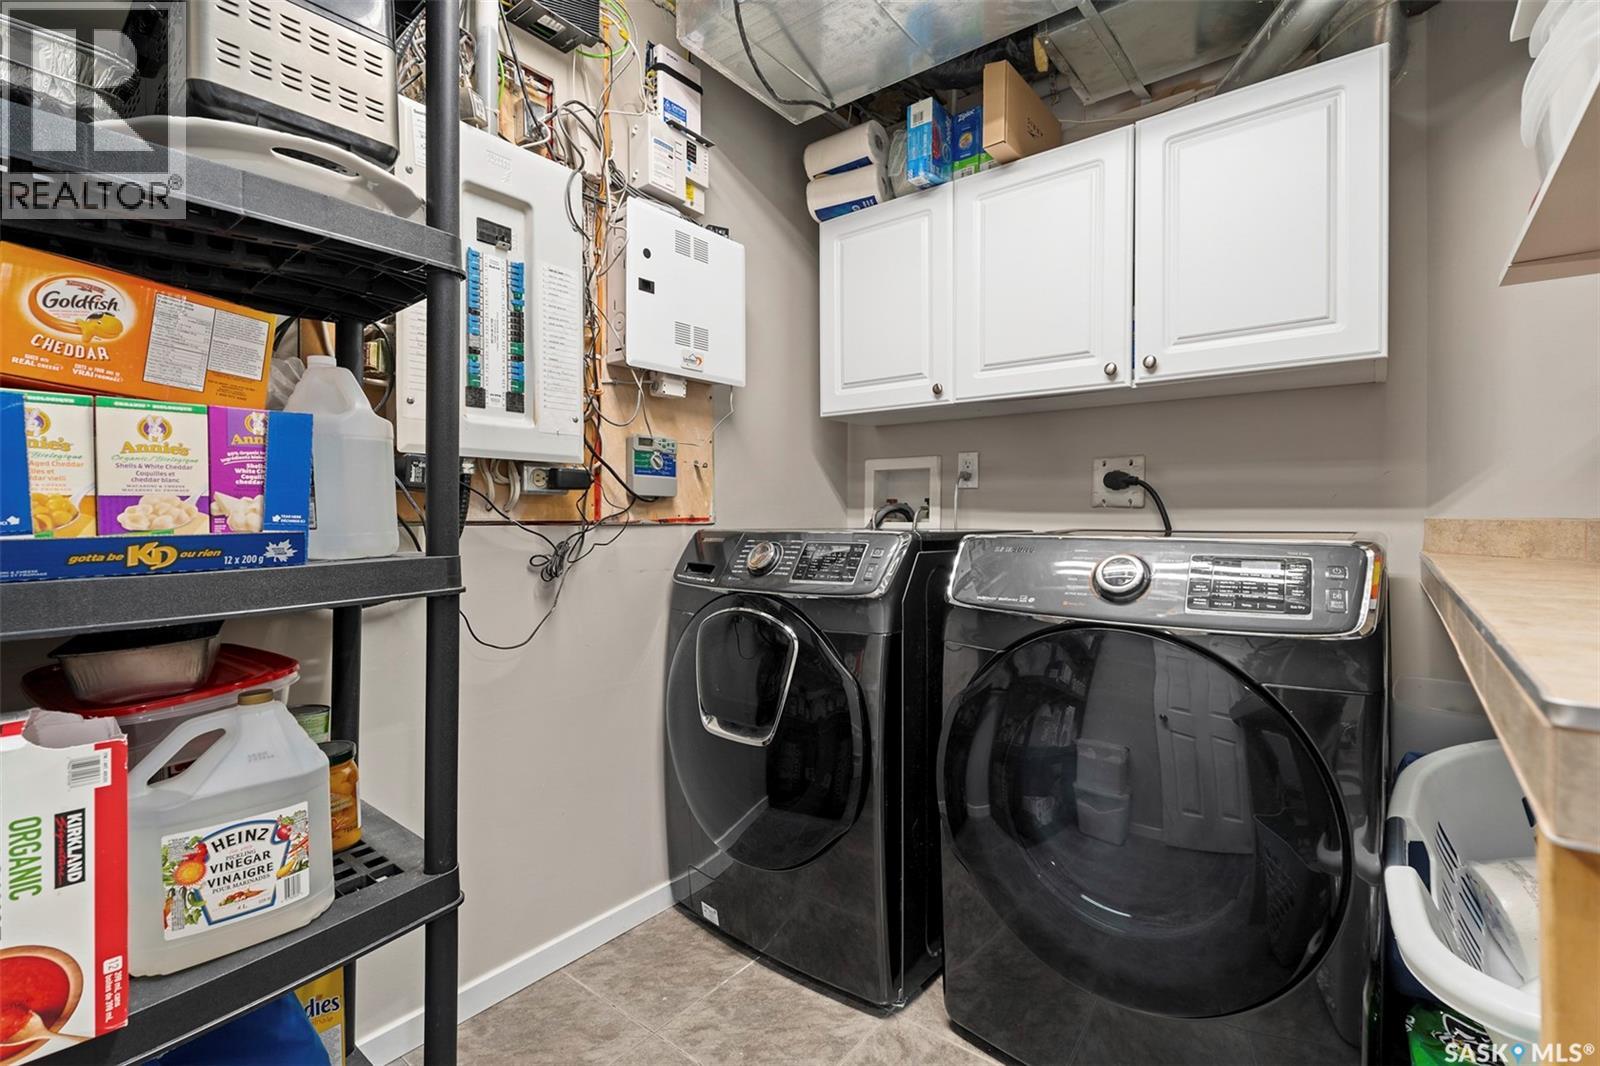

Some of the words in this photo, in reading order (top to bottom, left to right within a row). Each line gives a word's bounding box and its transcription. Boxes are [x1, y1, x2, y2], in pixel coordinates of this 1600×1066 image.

[42, 290, 119, 312] Goldfish
[31, 334, 110, 360] CHEDDAR
[120, 440, 191, 457] Annie's
[135, 470, 167, 478] Coquilles
[68, 552, 104, 565] gotta
[107, 552, 124, 562] be
[126, 541, 178, 570] KD
[180, 551, 194, 559] ou
[224, 555, 233, 565] 12
[241, 554, 258, 564] 200
[258, 556, 265, 566] g
[66, 812, 83, 883] KIRKLAND
[211, 827, 270, 853] HEINZ
[8, 815, 43, 901] ORGANIC
[209, 850, 272, 875] VINEGAR
[225, 848, 257, 861] PICKLING
[207, 862, 275, 889] VINAIGRE
[212, 884, 232, 895] POUR
[232, 874, 271, 889] MARINADES
[107, 959, 120, 971] 12
[304, 996, 340, 1018] dies
